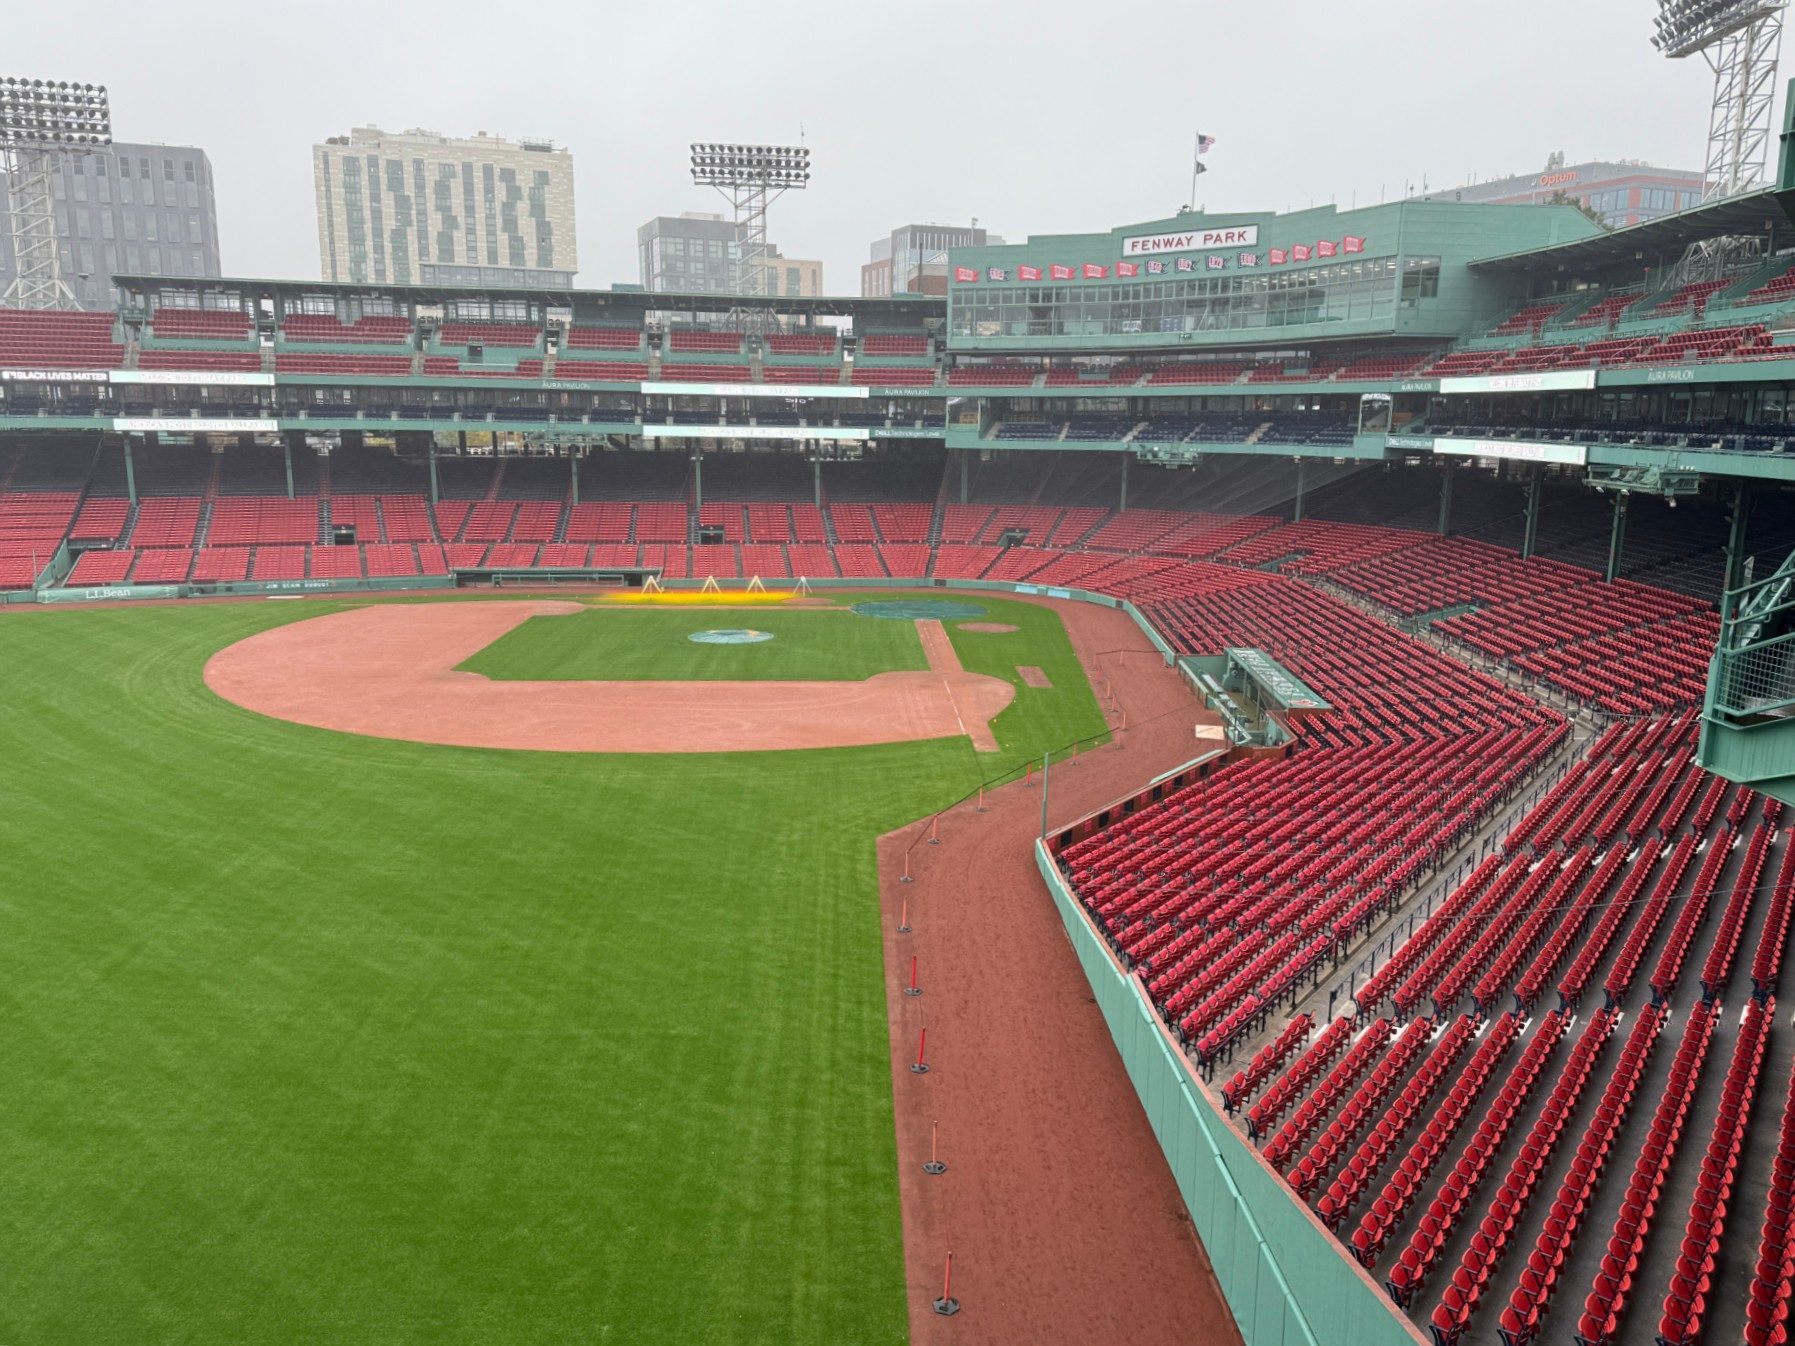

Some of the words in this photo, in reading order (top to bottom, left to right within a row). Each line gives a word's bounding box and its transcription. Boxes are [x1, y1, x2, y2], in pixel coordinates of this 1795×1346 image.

[1540, 171, 1578, 187] Optum
[1131, 235, 1194, 252] FENWAY
[1203, 230, 1247, 245] PARK
[17, 371, 47, 380] BLACK
[48, 371, 72, 380] LIVES
[73, 372, 108, 381] MATTER
